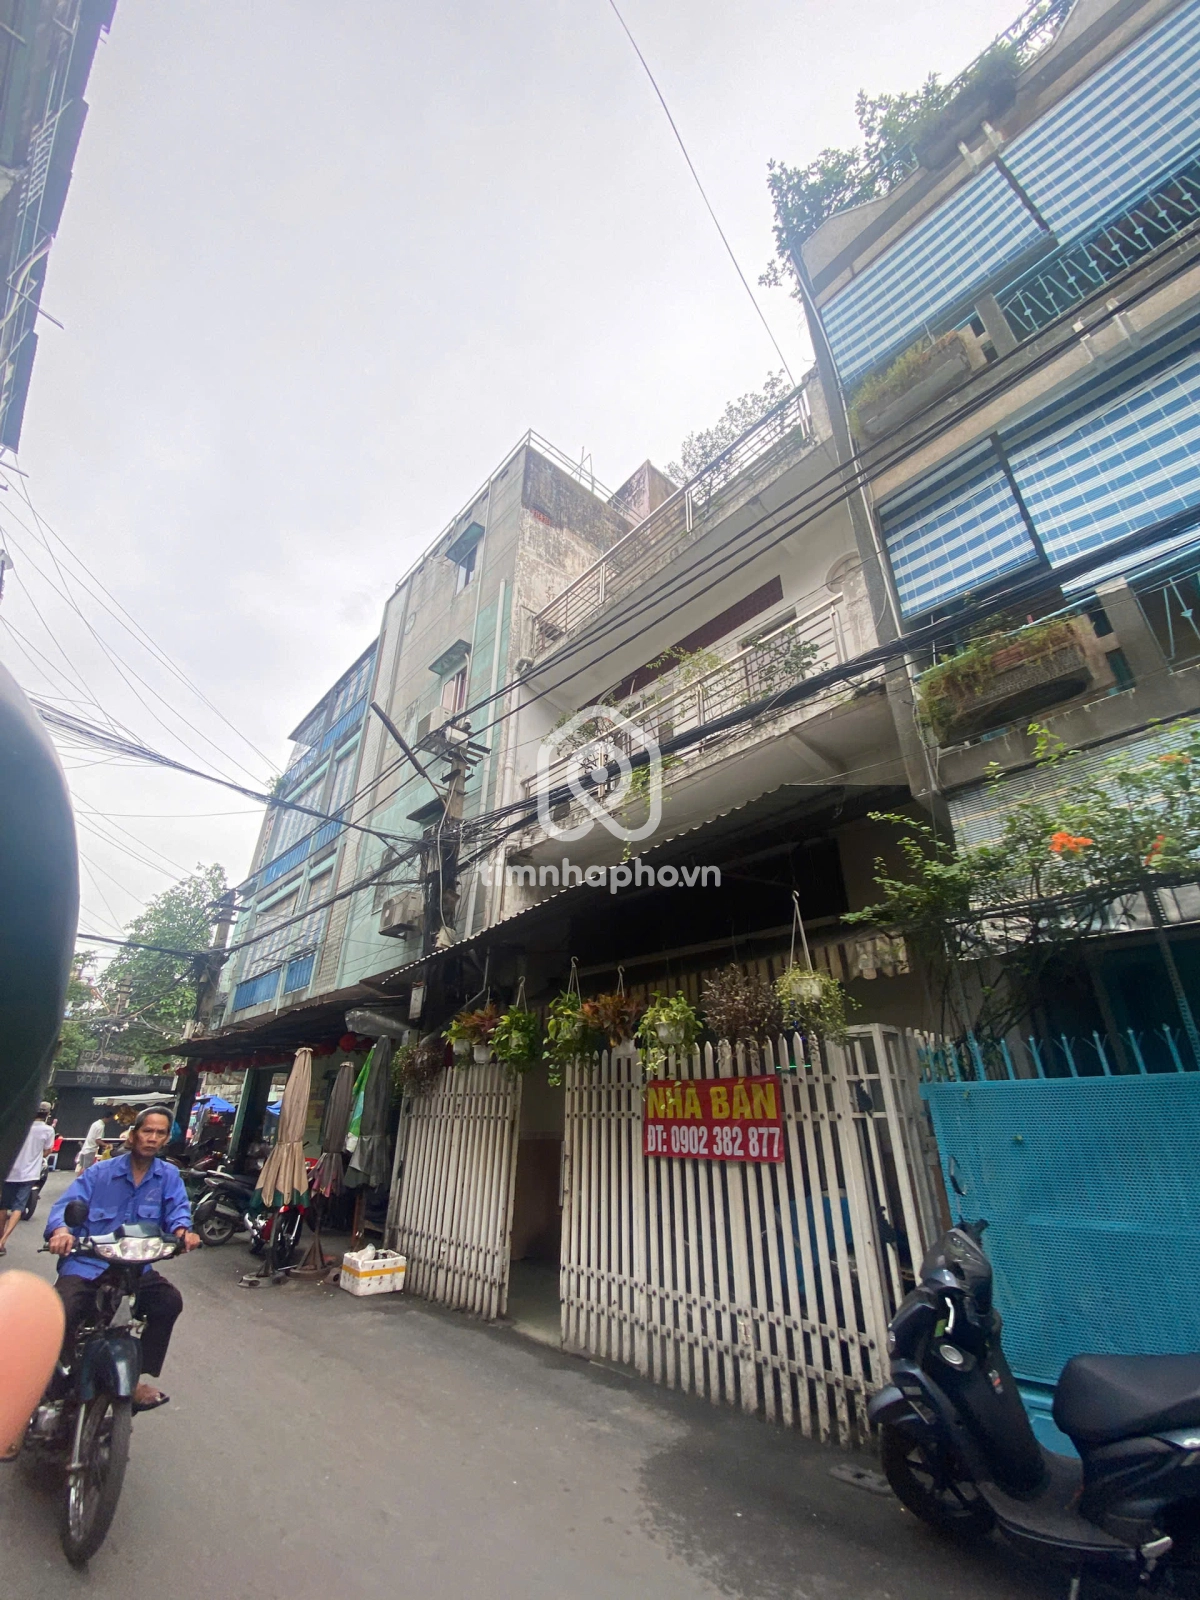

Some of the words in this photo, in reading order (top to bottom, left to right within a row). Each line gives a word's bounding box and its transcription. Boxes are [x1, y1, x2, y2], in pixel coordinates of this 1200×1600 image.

[647, 1081, 702, 1119] NHÀ
[710, 1078, 777, 1119] BÁN
[671, 1125, 708, 1154] 0902
[713, 1126, 744, 1155] 382
[748, 1127, 780, 1157] 877
